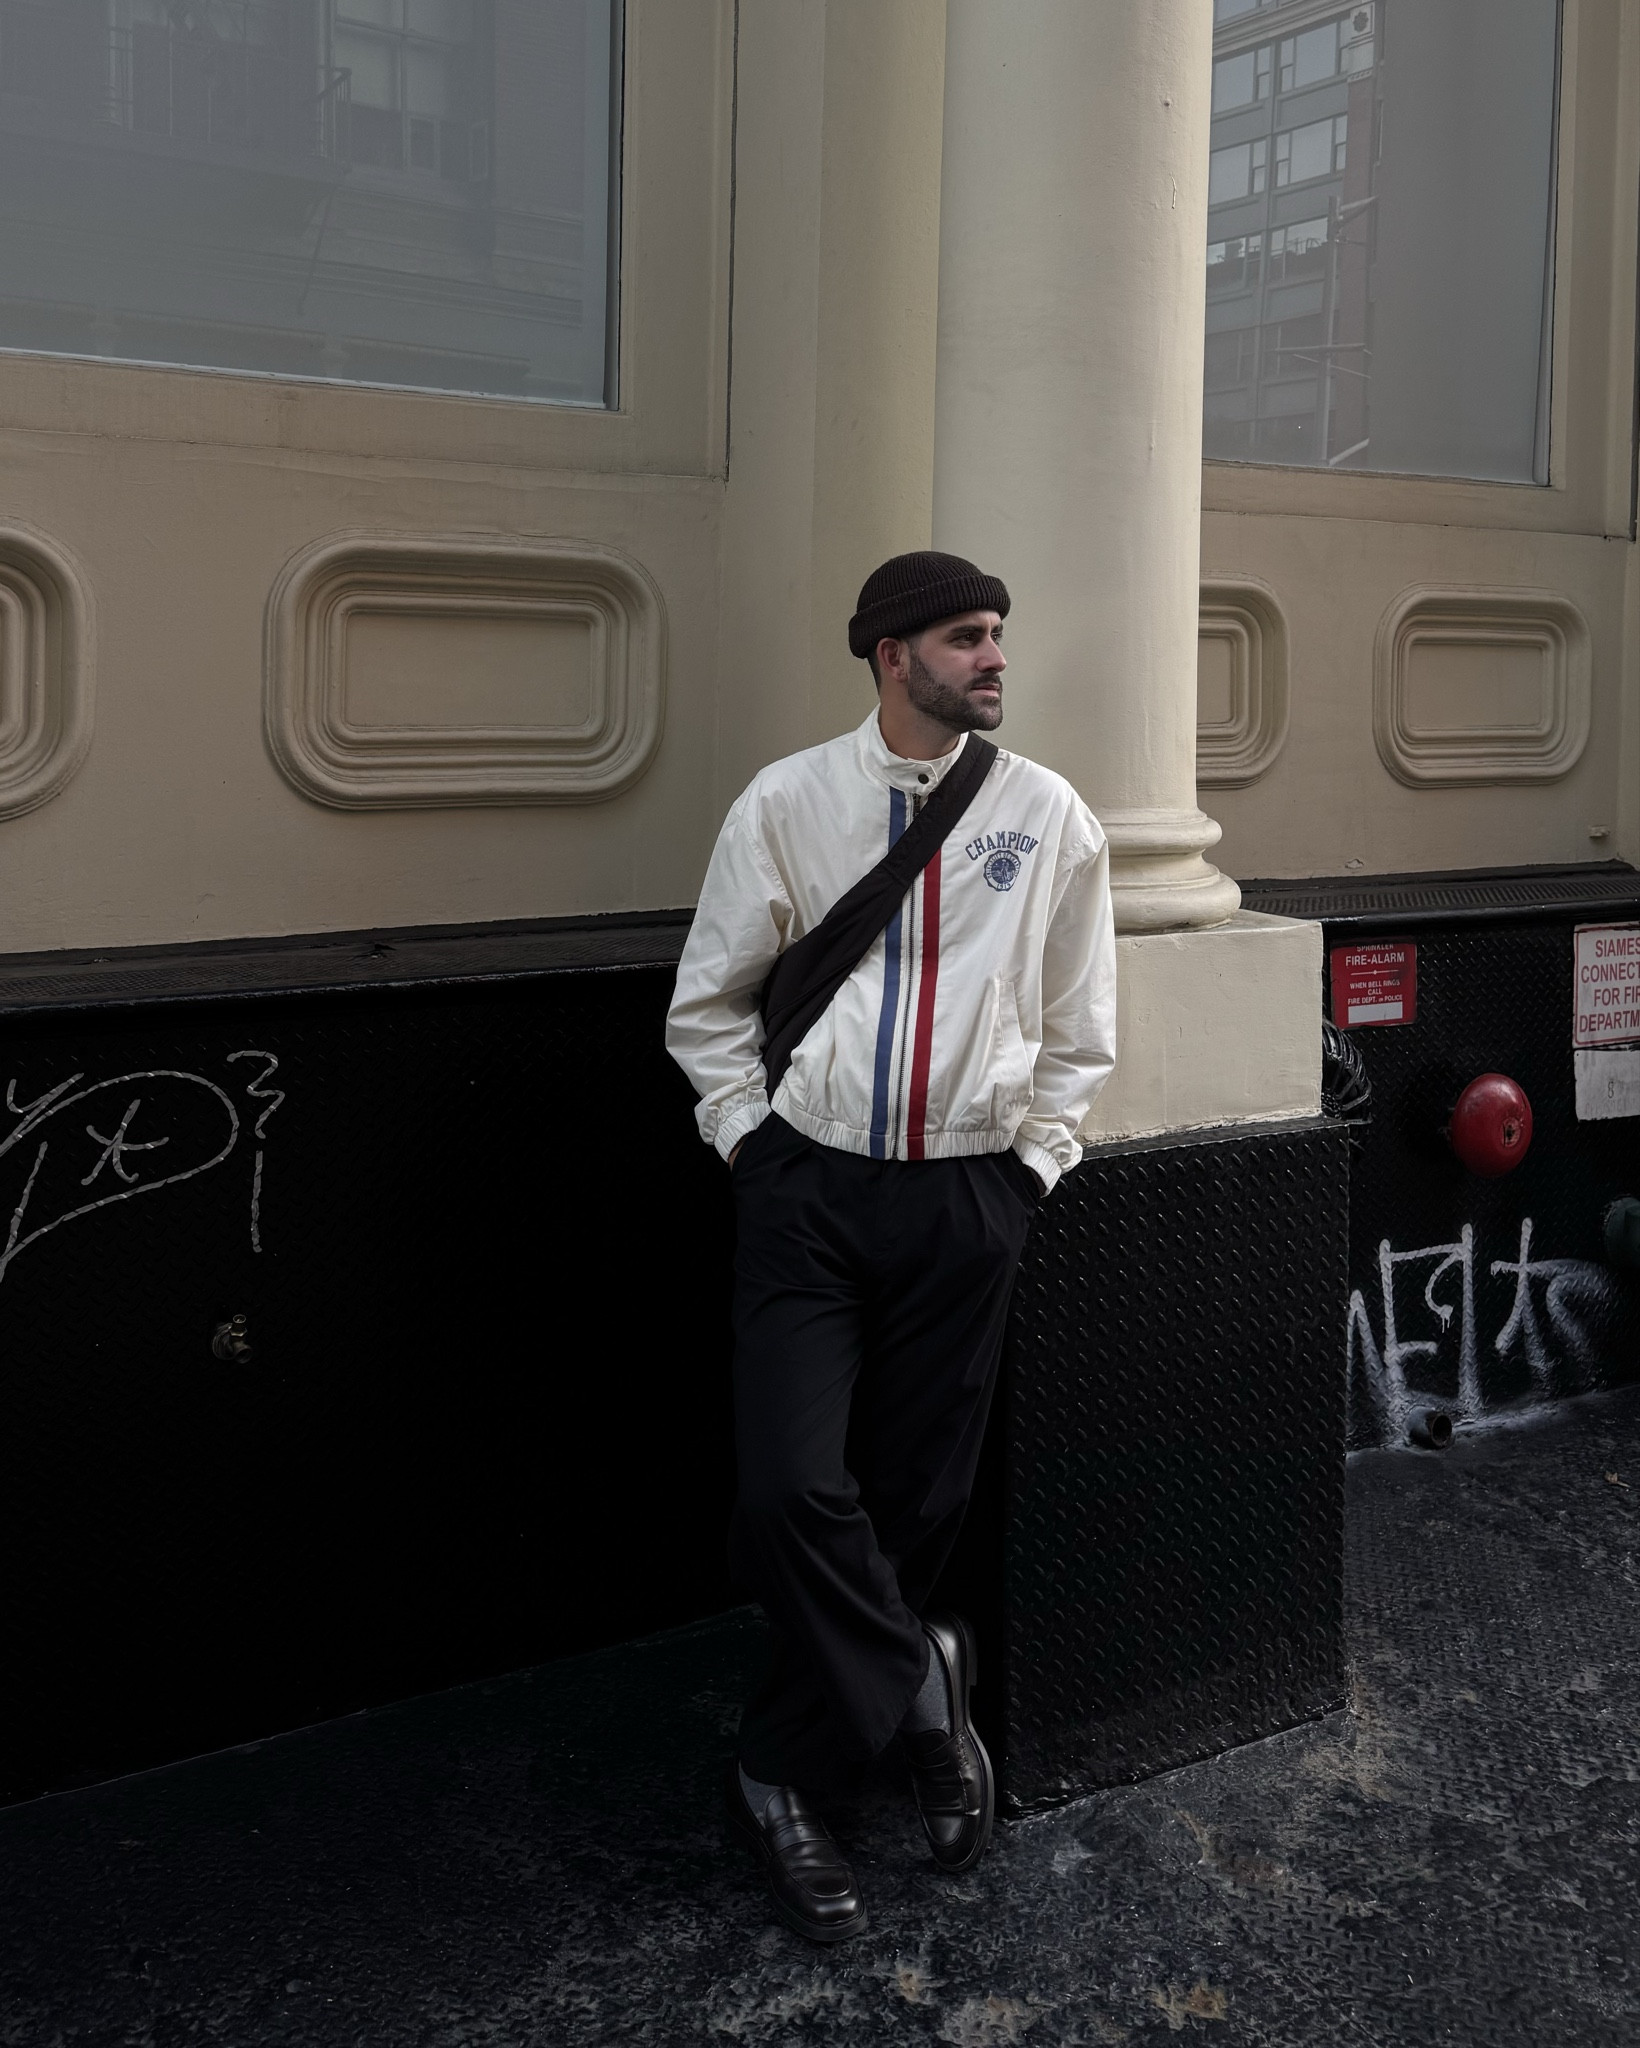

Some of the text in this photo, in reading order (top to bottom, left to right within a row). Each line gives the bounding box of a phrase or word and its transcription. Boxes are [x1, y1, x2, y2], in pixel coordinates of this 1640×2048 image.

[965, 831, 1039, 860] CHAMPION
[1345, 951, 1405, 967] FIRE-ALARM
[1350, 982, 1367, 990] WHEN
[1383, 979, 1400, 987] RINGS
[1368, 988, 1382, 996] CALL
[1348, 997, 1361, 1005] FIRE
[1384, 994, 1403, 1002] POLICE
[1594, 987, 1620, 1007] FOR
[1580, 1009, 1640, 1033] DEPARTM
